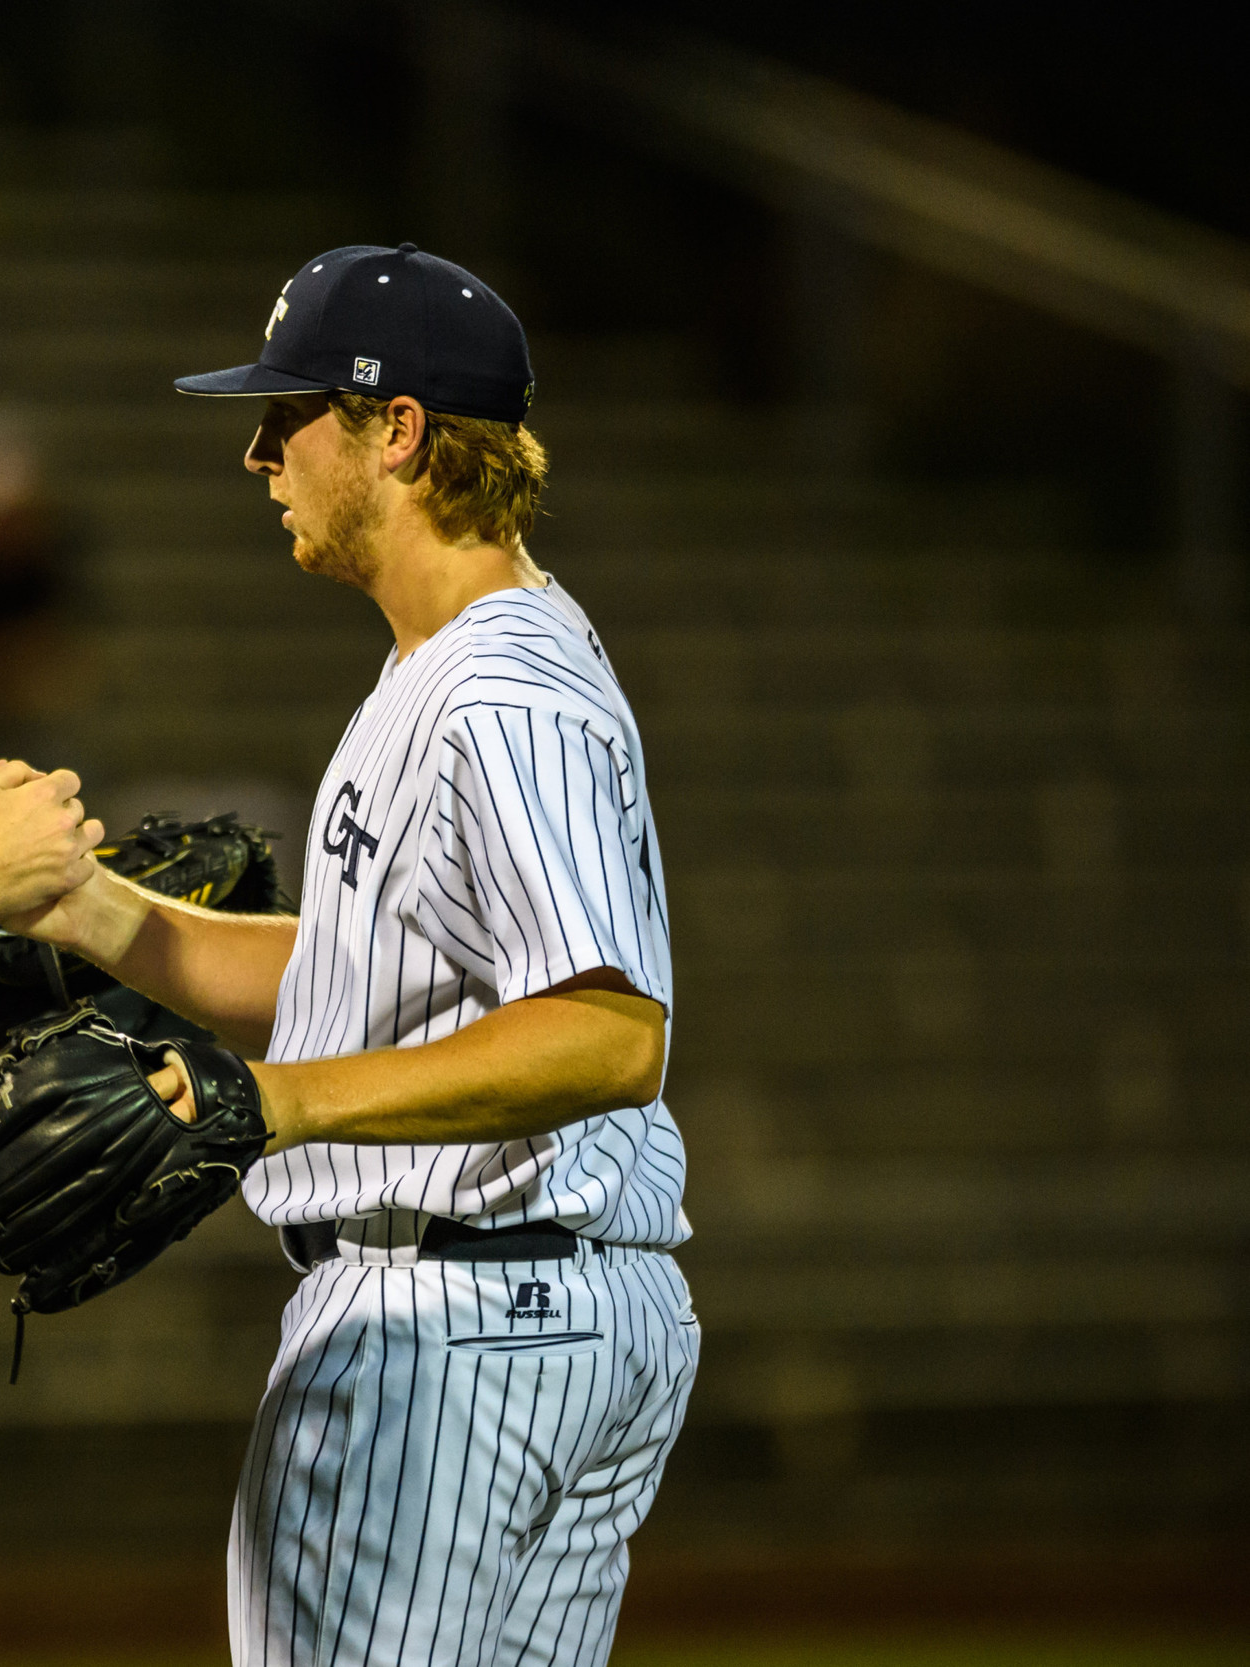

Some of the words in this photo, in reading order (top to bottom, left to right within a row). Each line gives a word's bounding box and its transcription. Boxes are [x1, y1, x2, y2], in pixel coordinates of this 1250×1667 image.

[323, 780, 380, 891] GT
[516, 1282, 550, 1307] R
[505, 1309, 562, 1318] RUSSELL
